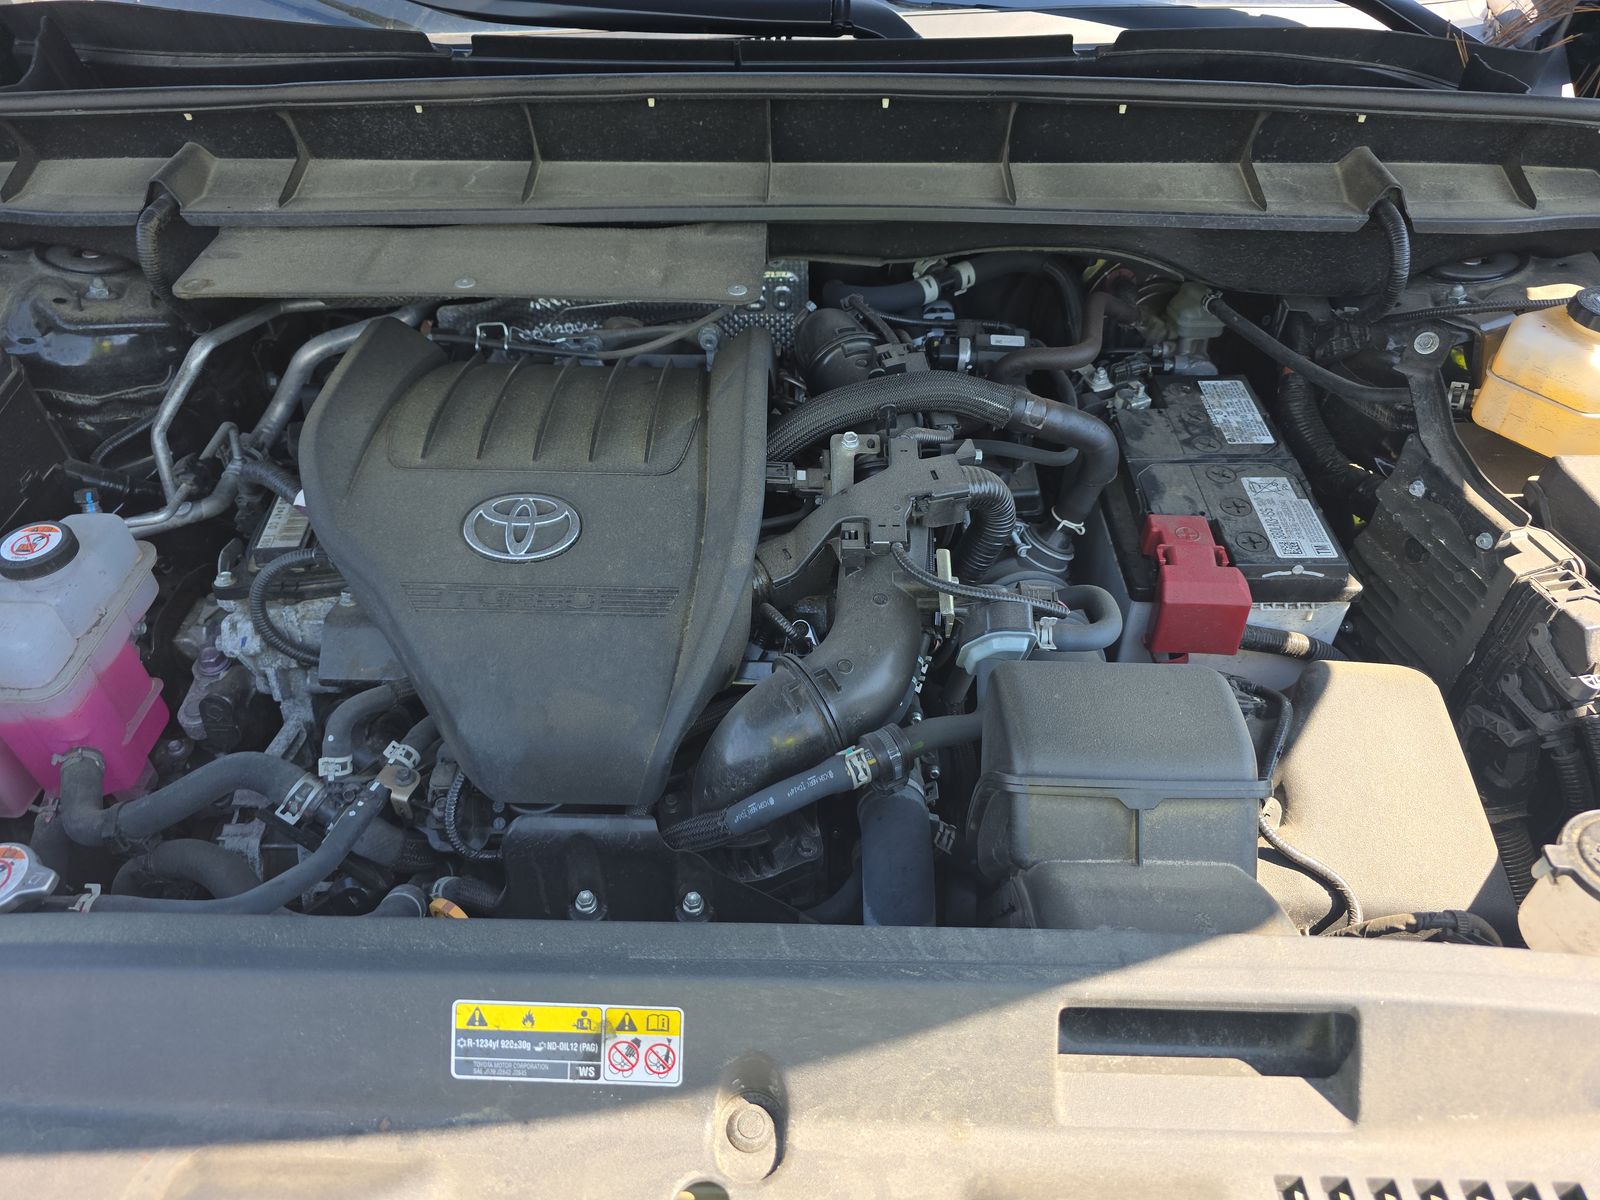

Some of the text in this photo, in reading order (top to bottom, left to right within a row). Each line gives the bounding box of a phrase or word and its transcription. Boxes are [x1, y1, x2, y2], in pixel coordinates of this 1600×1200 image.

[467, 1038, 599, 1054] R-1234yf 920±30g ND-OIL12 (PAG)
[494, 1061, 513, 1069] MOTOR
[513, 1062, 549, 1071] CORPORATION
